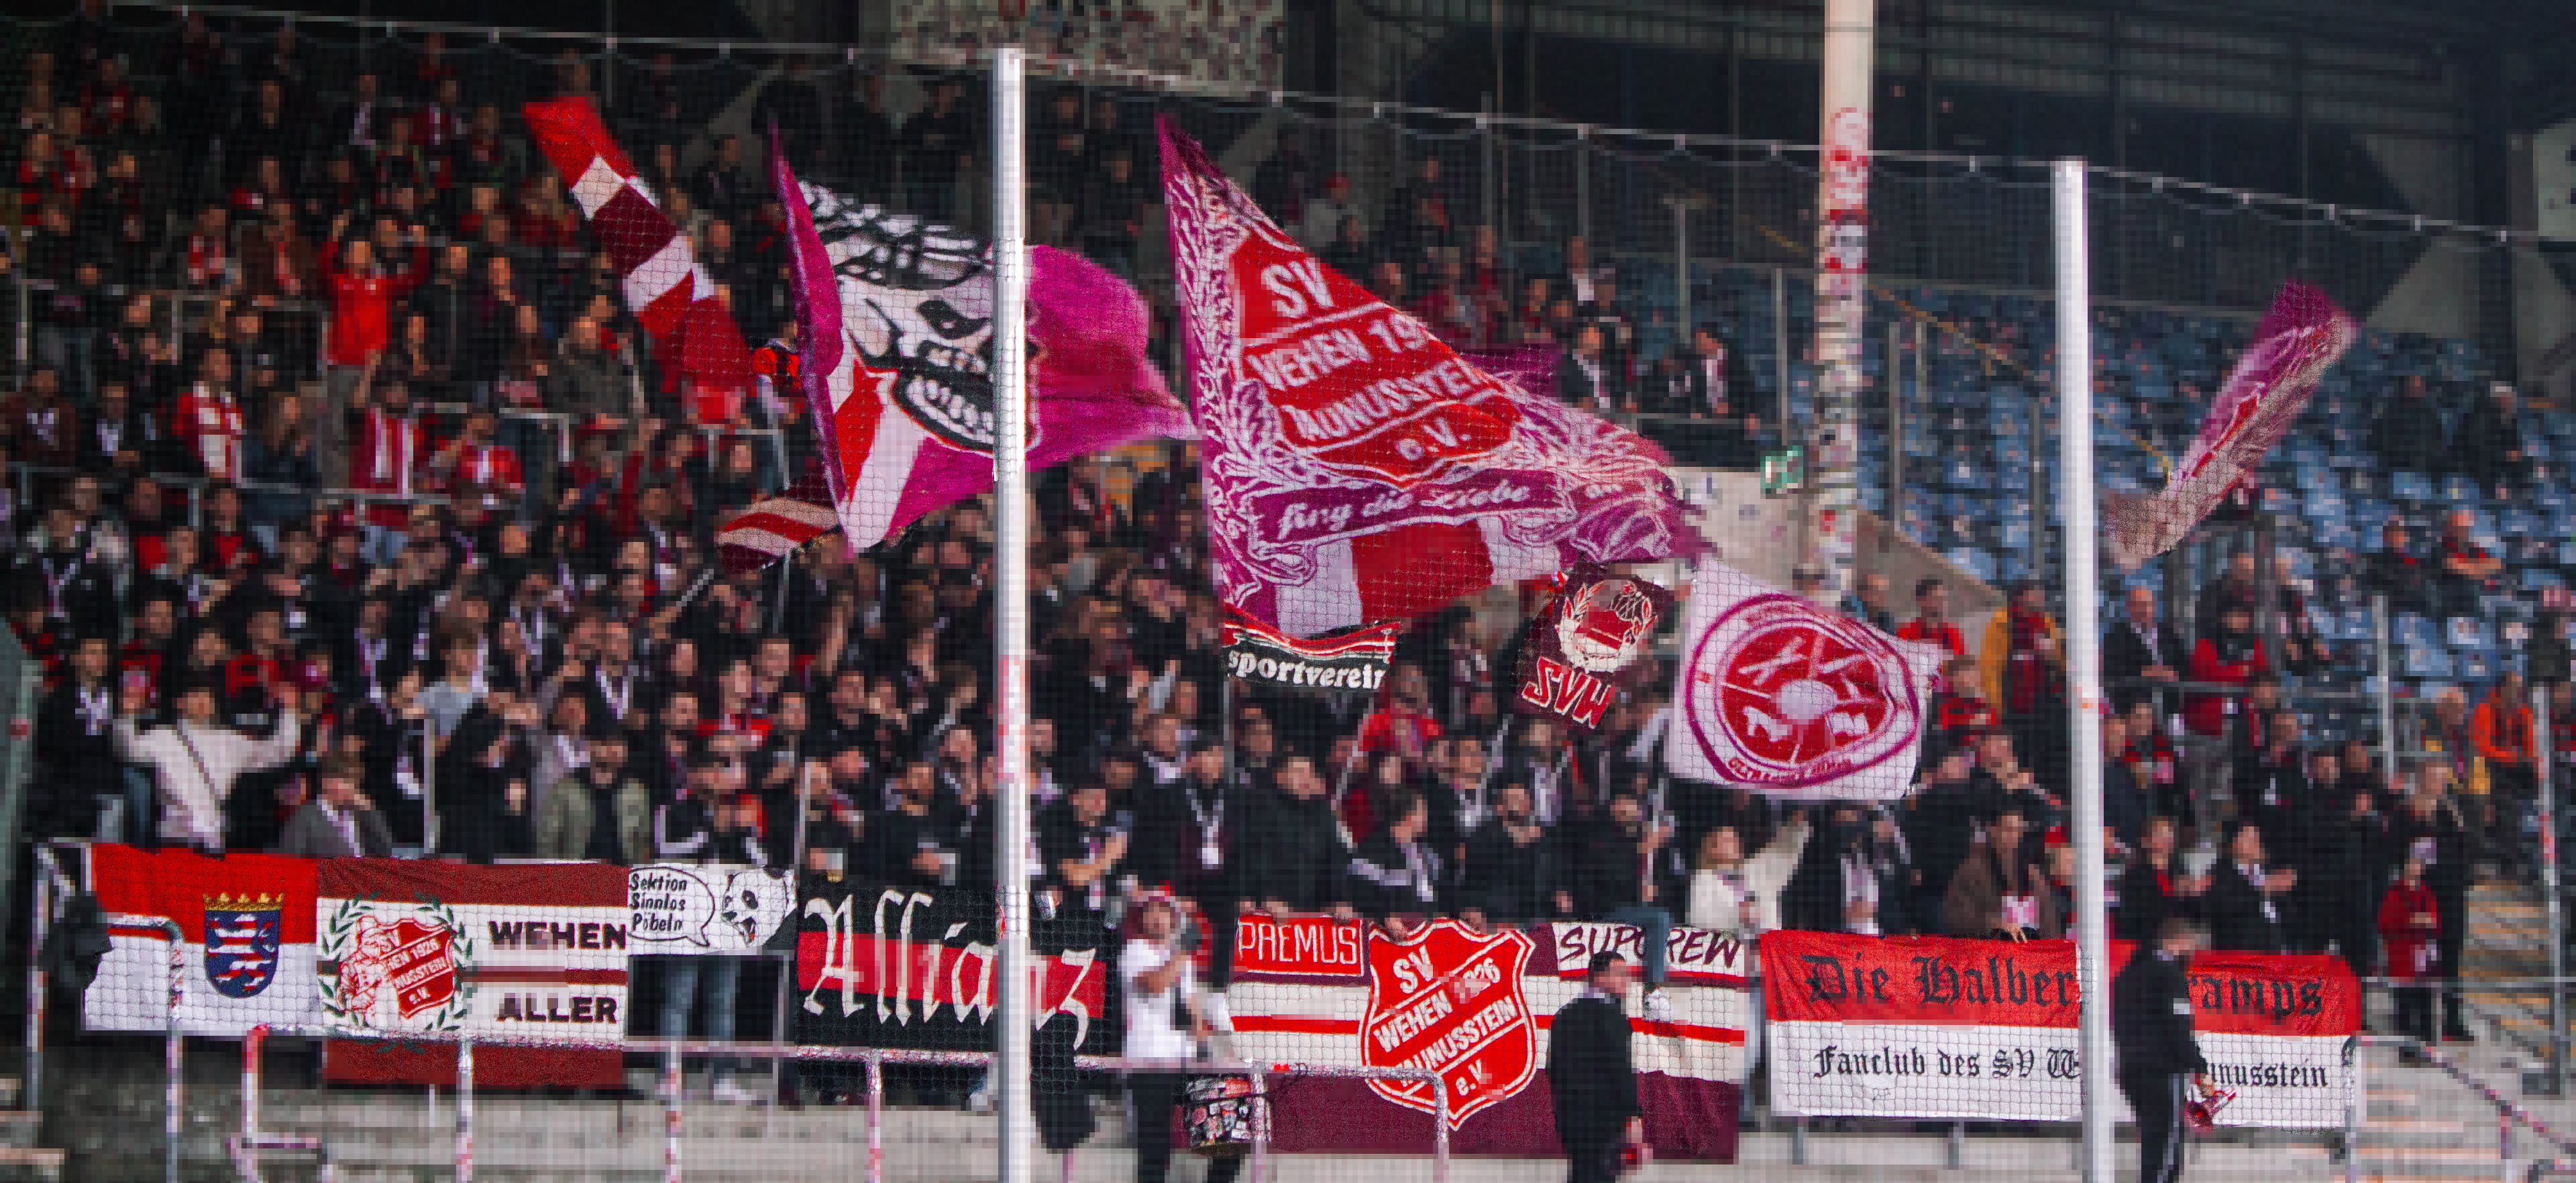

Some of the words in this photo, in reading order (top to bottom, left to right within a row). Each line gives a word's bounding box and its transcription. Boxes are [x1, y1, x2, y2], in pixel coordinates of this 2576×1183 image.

[1262, 259, 1333, 319] SV
[629, 872, 688, 891] Sektion
[629, 892, 686, 911] Sinnlos
[488, 921, 626, 950] WEHEN
[1393, 944, 1438, 994] SV
[1801, 952, 1891, 1004] Die
[1911, 955, 2075, 1008] Halber
[2185, 975, 2323, 1024] ramps
[496, 992, 618, 1024] ALLER
[1373, 989, 1453, 1053] WEHEN
[1813, 1045, 1925, 1077] Fanclub
[1937, 1049, 1980, 1077] des
[1992, 1048, 2035, 1079] SV
